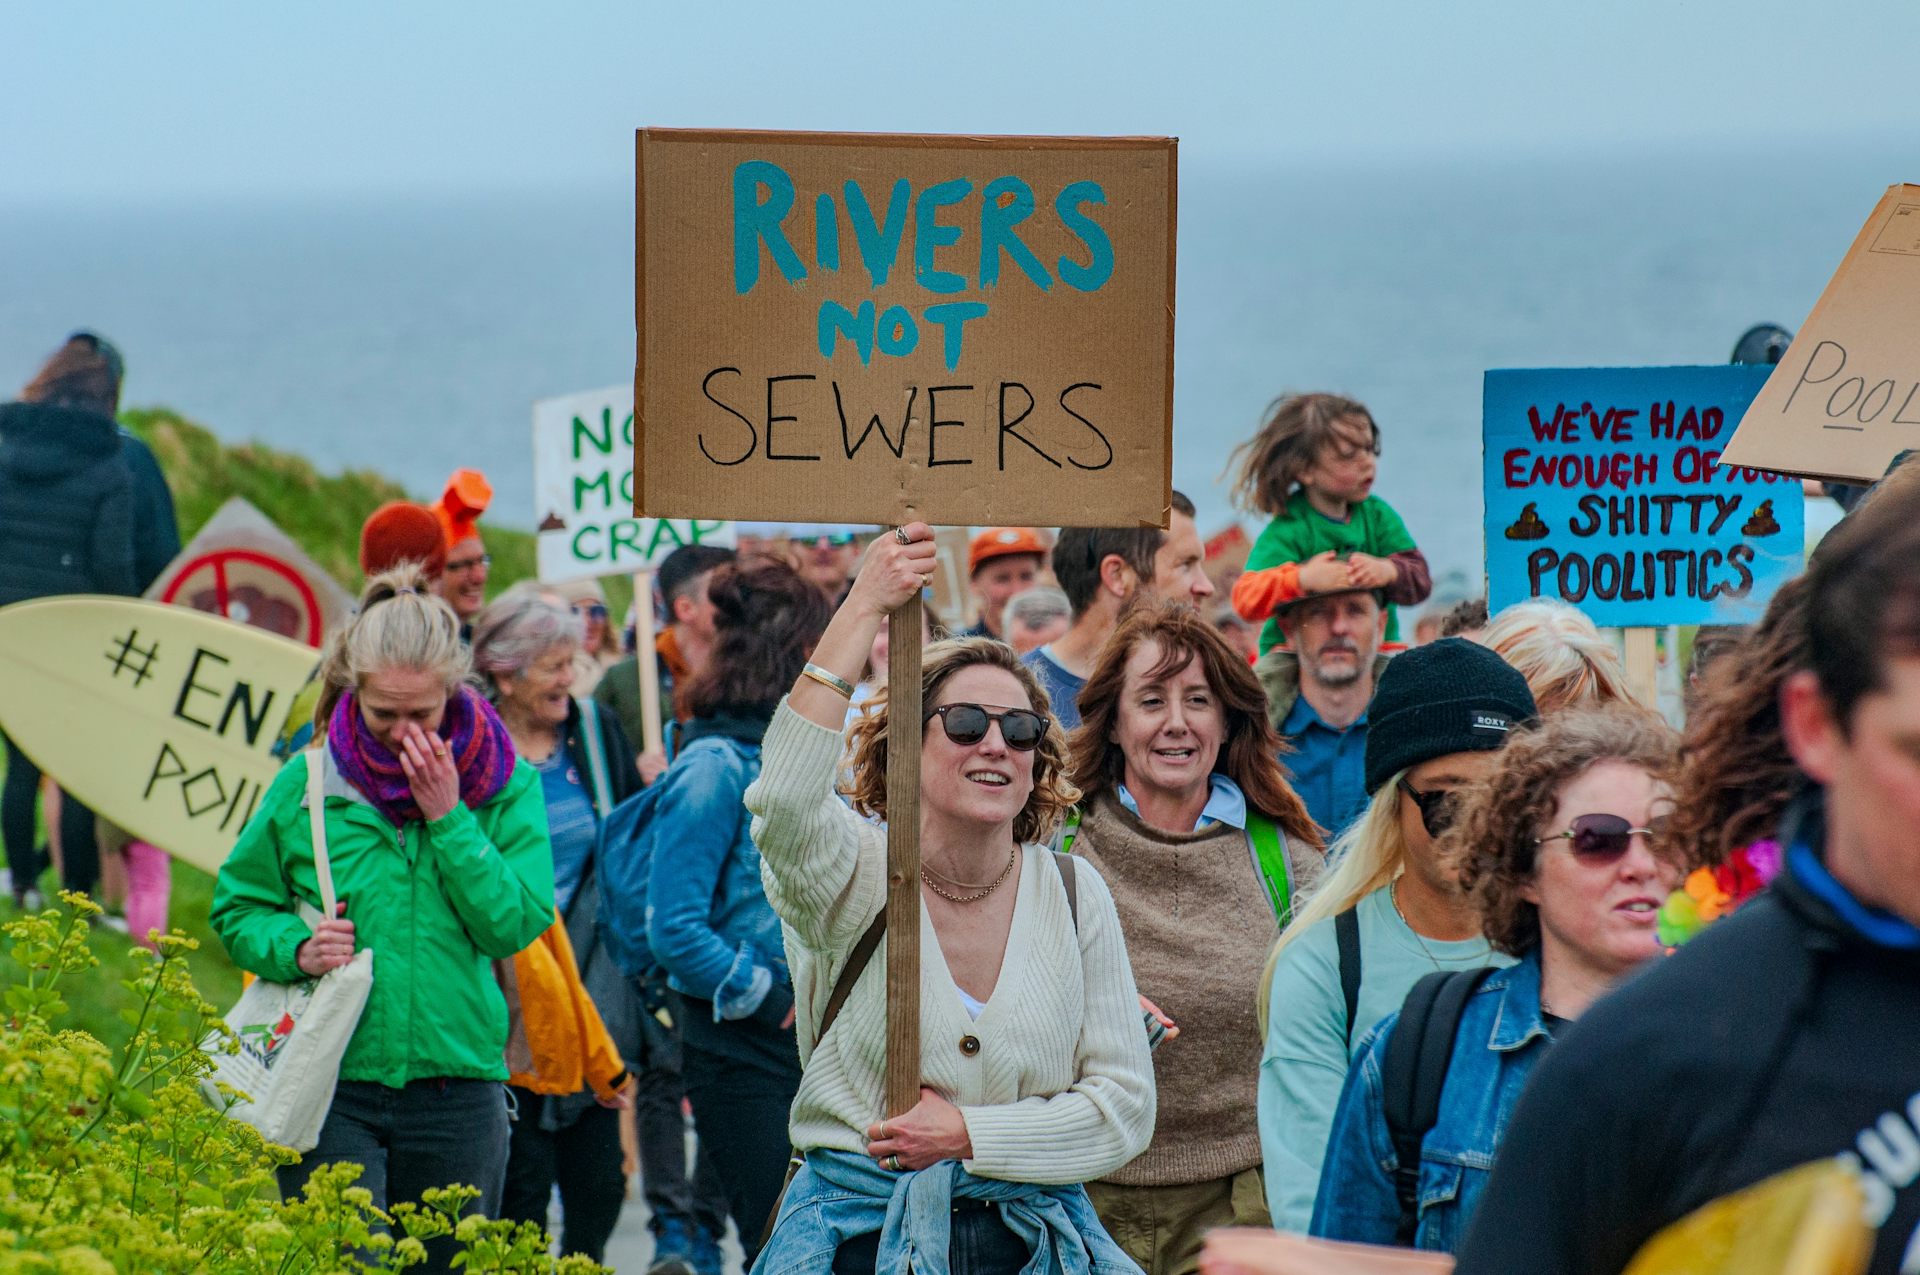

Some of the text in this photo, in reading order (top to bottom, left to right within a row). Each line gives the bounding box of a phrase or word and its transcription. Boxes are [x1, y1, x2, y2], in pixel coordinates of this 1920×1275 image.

[733, 159, 1115, 295] RIVERS
[817, 300, 989, 372] NOT
[698, 366, 1114, 471] SEWERS
[1527, 400, 1725, 443] WE'VE HAD
[1503, 448, 1658, 491] ENOUGH
[1672, 446, 1722, 485] OF
[1569, 494, 1742, 537] SHITTY
[1527, 543, 1755, 603] POOLITICS
[1477, 715, 1506, 727] ROXY
